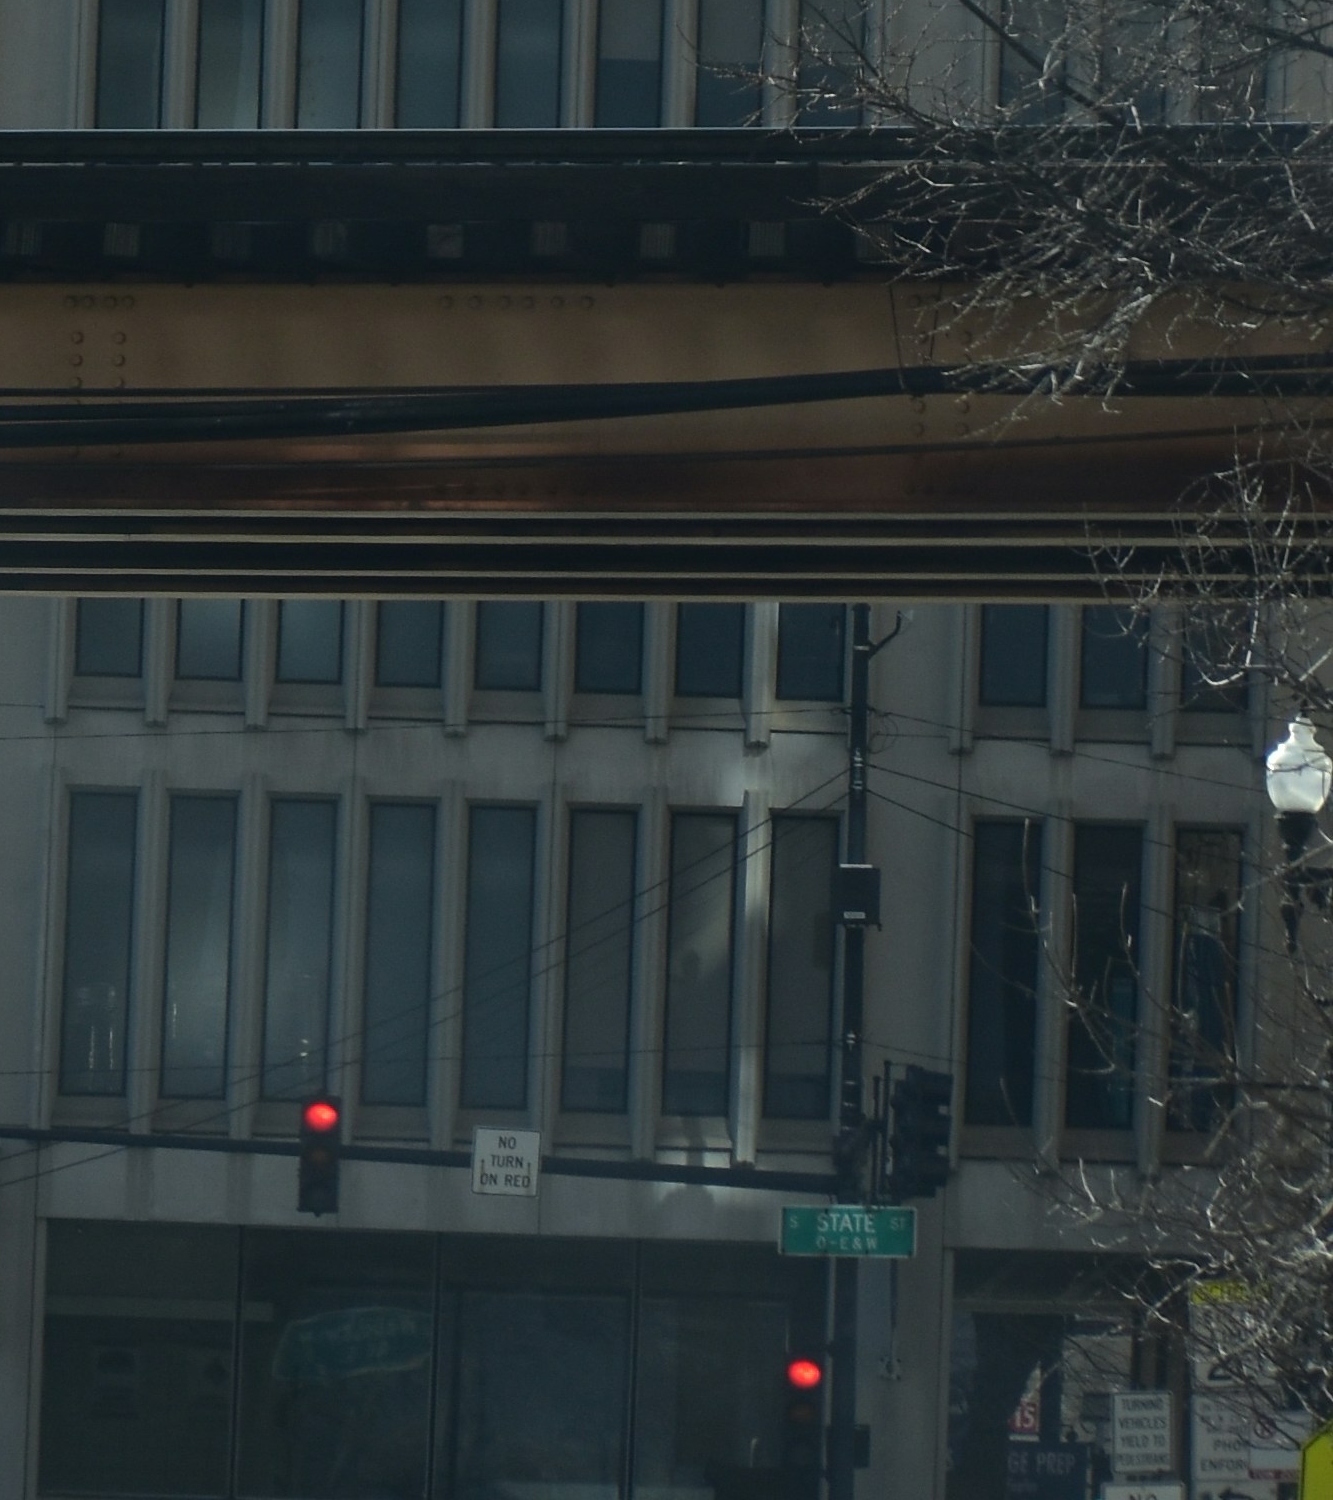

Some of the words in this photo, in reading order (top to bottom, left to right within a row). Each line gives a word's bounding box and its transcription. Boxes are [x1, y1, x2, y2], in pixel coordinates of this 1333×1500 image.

[498, 1136, 517, 1150] NO
[490, 1154, 524, 1169] TURN
[479, 1172, 498, 1186] ON
[504, 1174, 531, 1189] RED
[789, 1214, 799, 1229] S
[816, 1213, 876, 1233] STATE
[890, 1217, 907, 1231] ST
